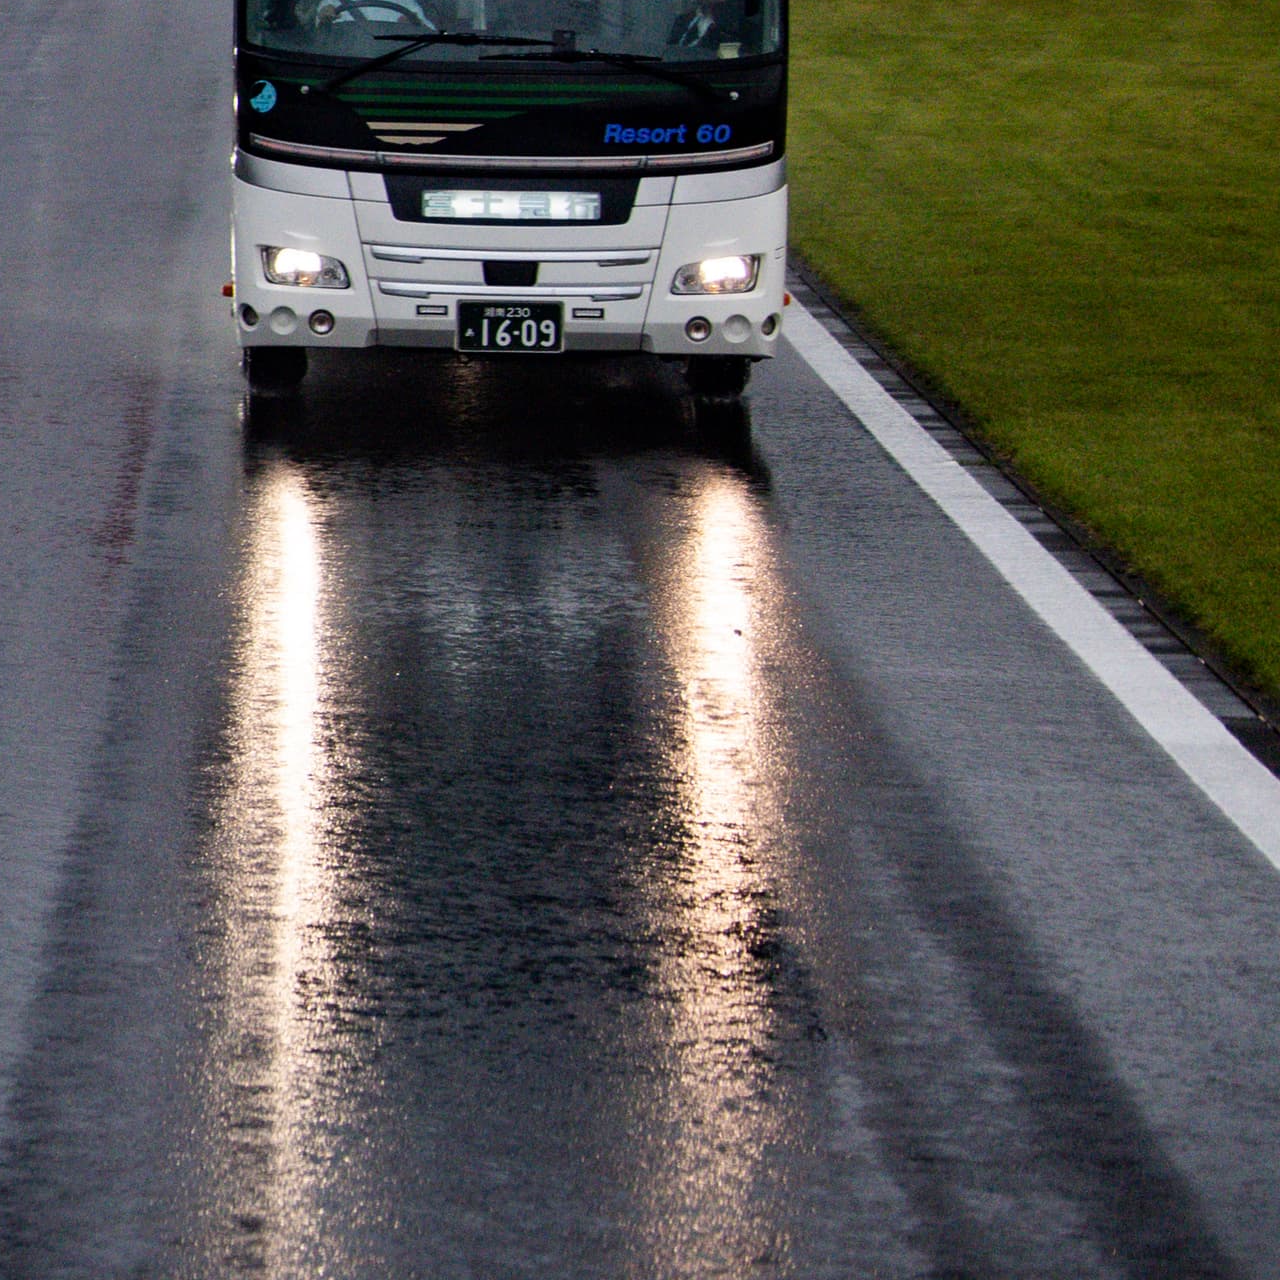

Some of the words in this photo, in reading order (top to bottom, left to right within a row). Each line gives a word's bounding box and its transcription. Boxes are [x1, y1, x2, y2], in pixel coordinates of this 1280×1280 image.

[603, 124, 688, 144] Resort
[696, 124, 732, 144] 60
[481, 318, 556, 347] 16-09
